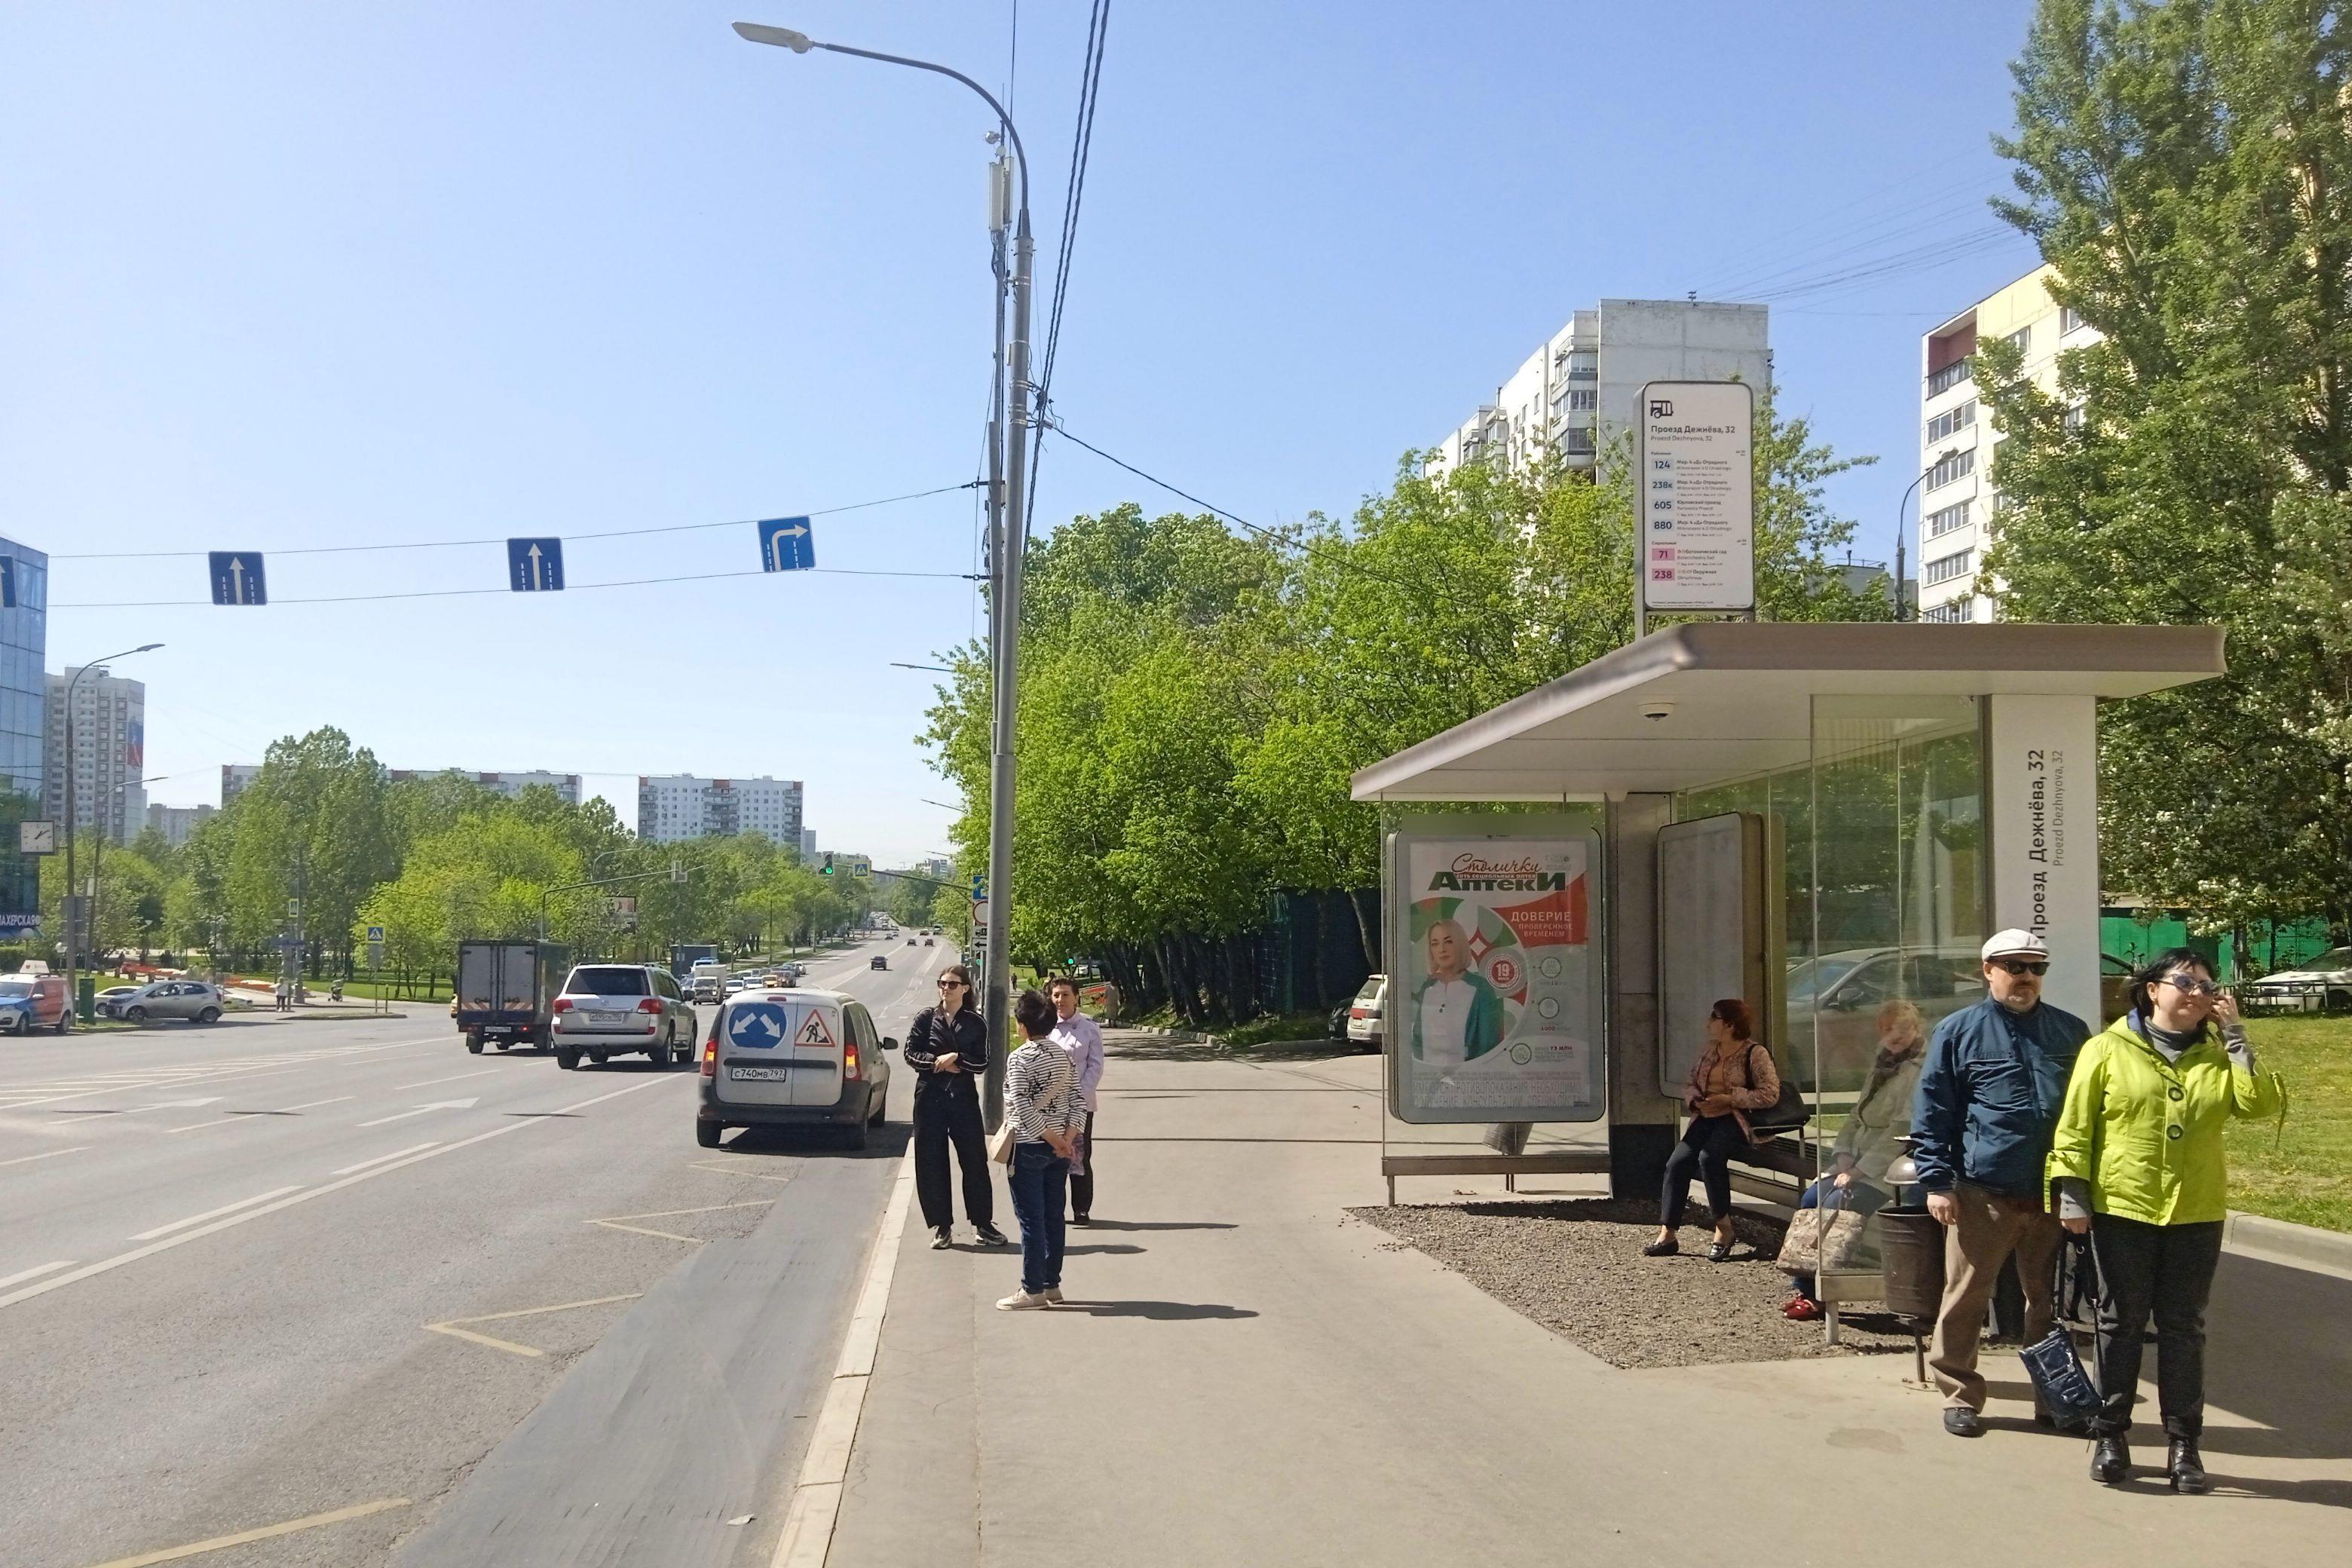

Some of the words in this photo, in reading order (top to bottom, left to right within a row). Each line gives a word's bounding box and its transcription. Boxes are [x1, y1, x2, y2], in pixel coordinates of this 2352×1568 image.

[1651, 425, 1683, 433] Проезд
[1684, 425, 1724, 433] Дежнёва,
[1655, 461, 1670, 469] 124
[1652, 481, 1673, 489] 238к
[1659, 550, 1668, 559] 71
[1655, 571, 1672, 579] 238
[2028, 749, 2044, 771] 32
[2052, 751, 2063, 763] 32
[2052, 766, 2066, 825] Dezhnyova,
[2029, 776, 2047, 863] Дежнёва,
[2053, 830, 2064, 867] Proezd
[1451, 853, 1541, 873] Столички
[2030, 871, 2048, 939] Проезд
[0, 914, 35, 926] АХЕРСКАЯ
[1511, 911, 1571, 923] ДОВЕРИЕ
[1496, 963, 1509, 976] 19
